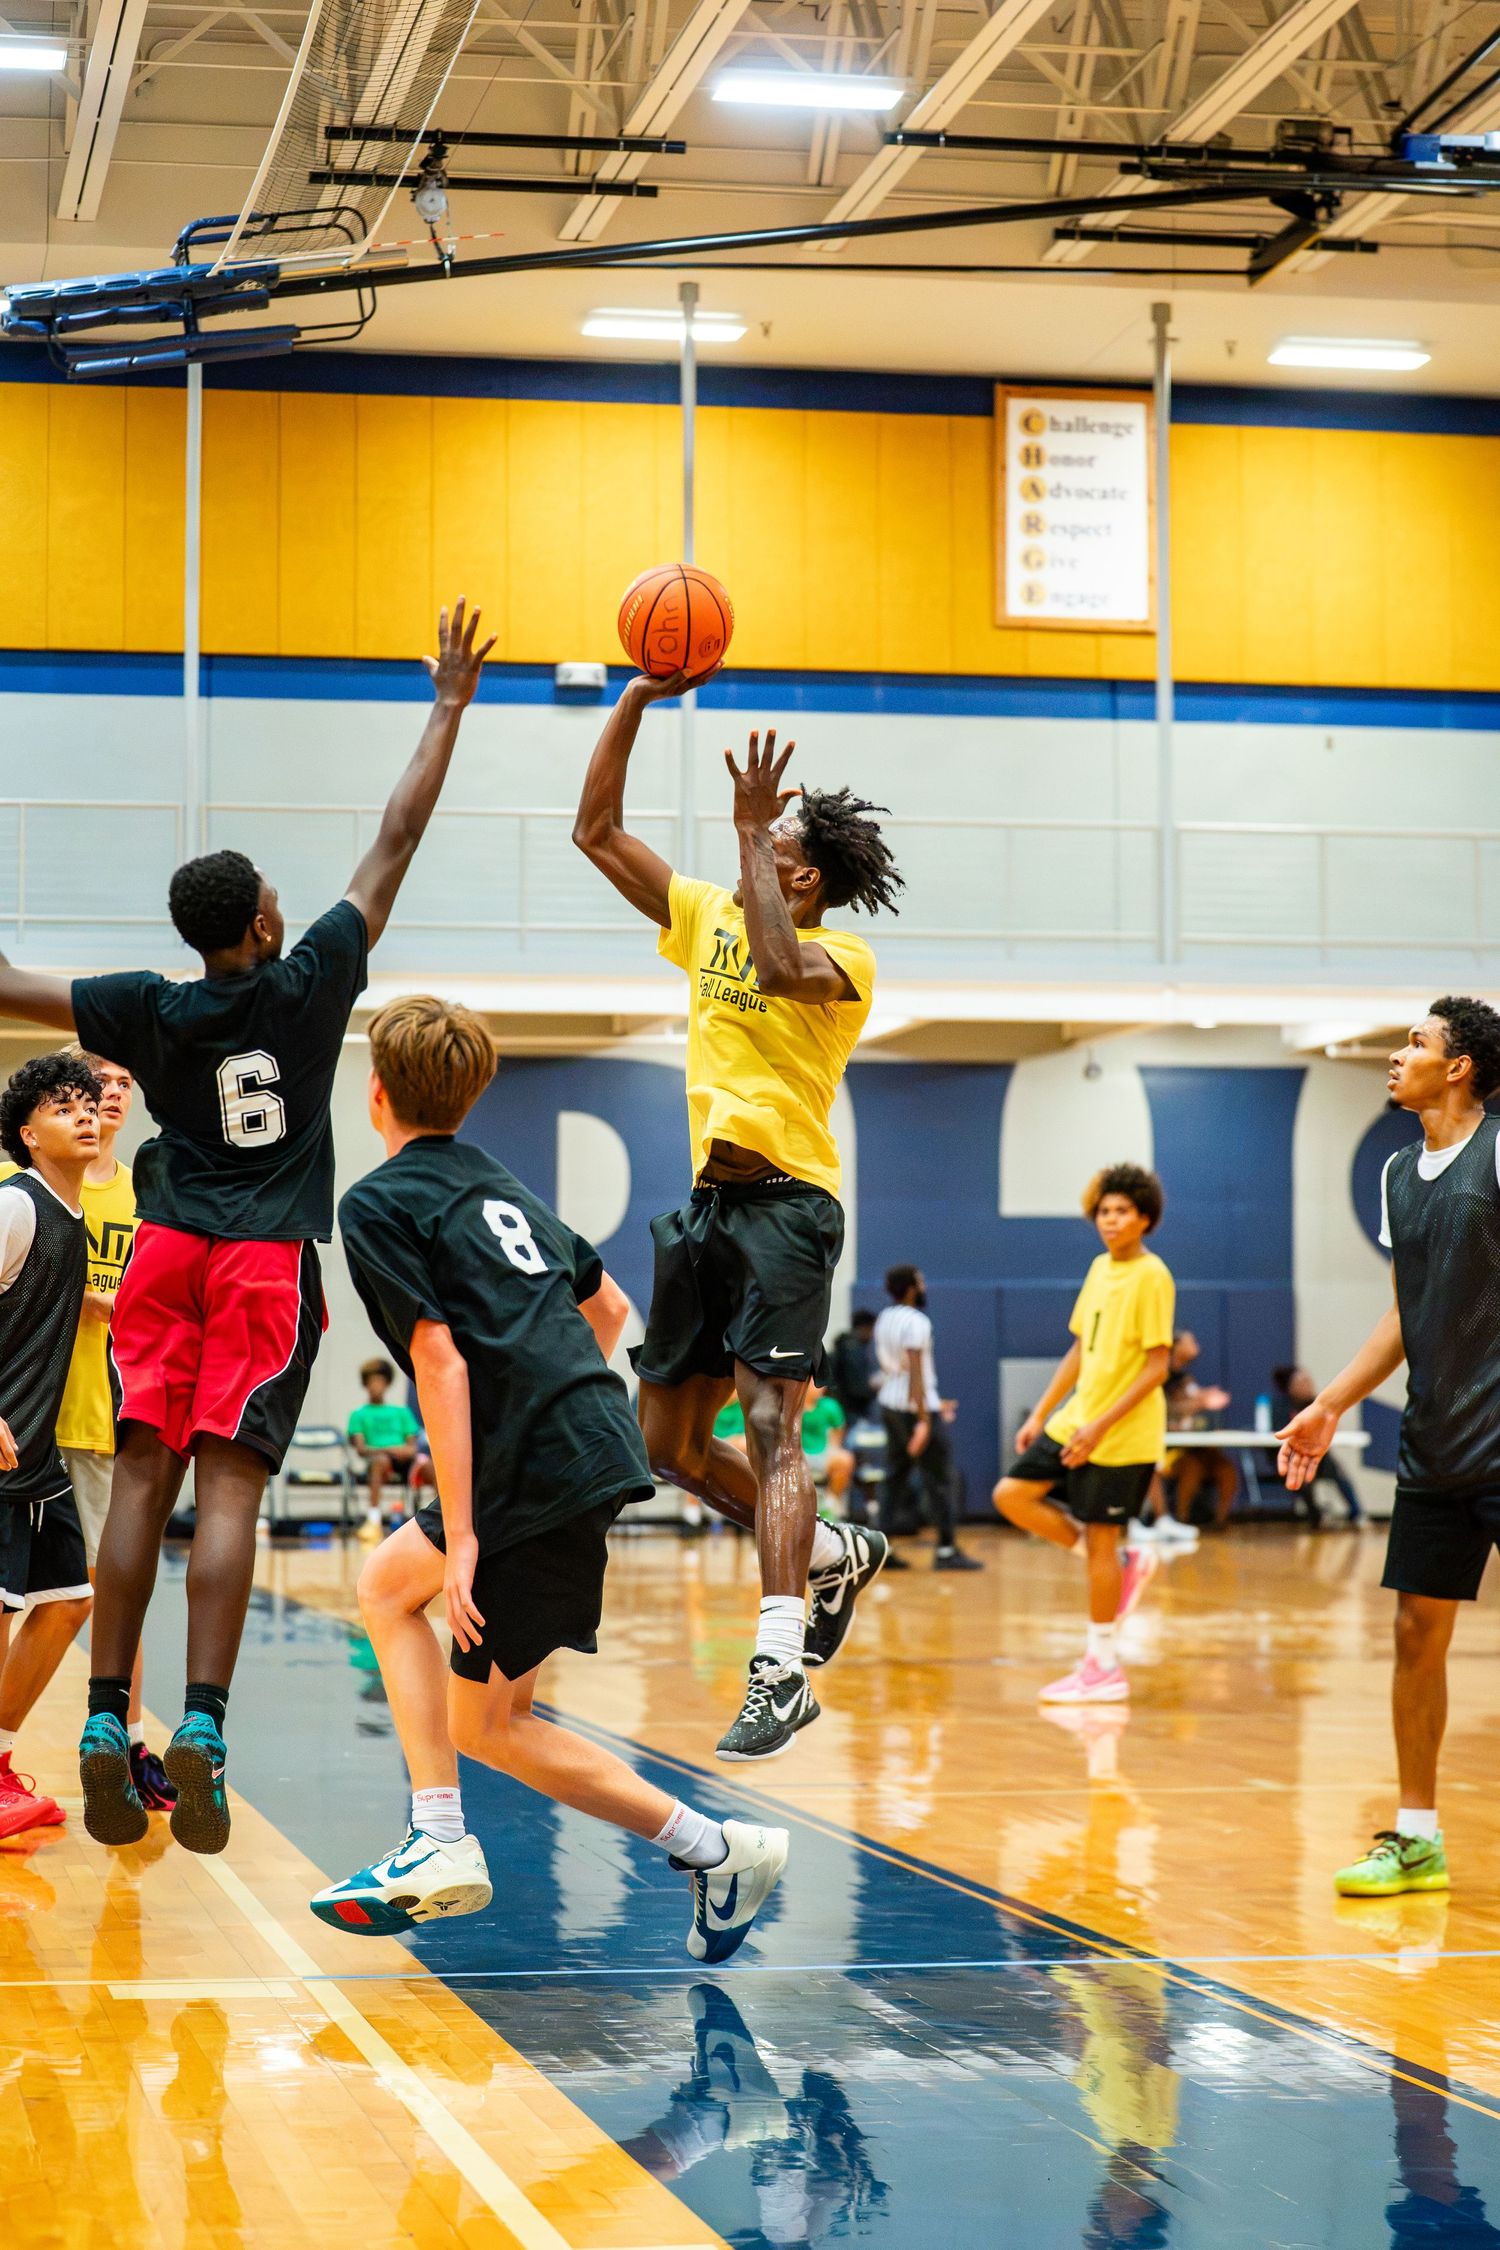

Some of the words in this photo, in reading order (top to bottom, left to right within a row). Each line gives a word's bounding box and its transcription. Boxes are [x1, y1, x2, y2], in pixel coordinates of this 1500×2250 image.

[1021, 412, 1135, 438] Challenge
[1022, 445, 1097, 468] Honor
[1022, 480, 1131, 500] Advocate
[1023, 514, 1113, 540] Respect
[714, 979, 767, 1013] League
[216, 1049, 287, 1148] 6
[482, 1199, 549, 1275] 8
[416, 1791, 454, 1803] Supreme
